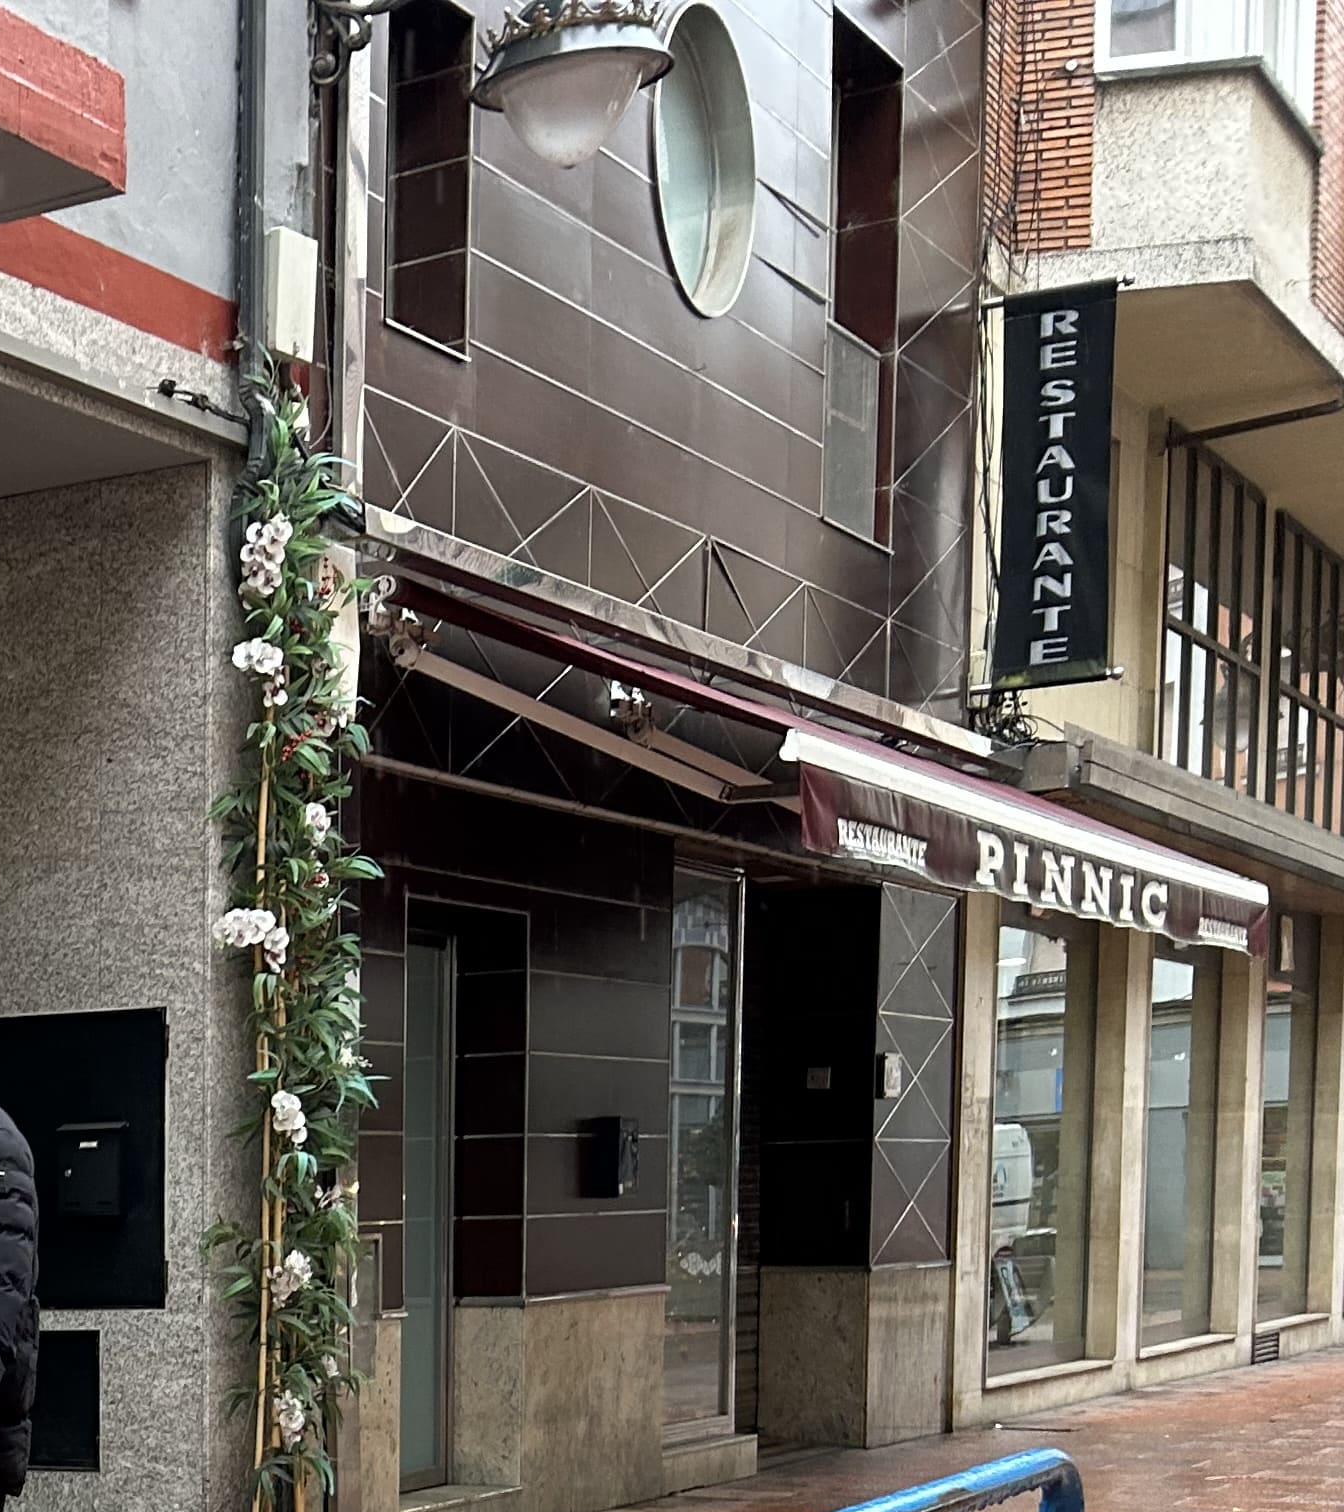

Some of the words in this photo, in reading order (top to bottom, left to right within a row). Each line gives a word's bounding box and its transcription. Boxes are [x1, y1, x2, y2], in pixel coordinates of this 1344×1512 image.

[1028, 309, 1080, 667] RESTAURANTE
[837, 817, 928, 867] RESTAURANTE
[976, 831, 1168, 927] PINNIC
